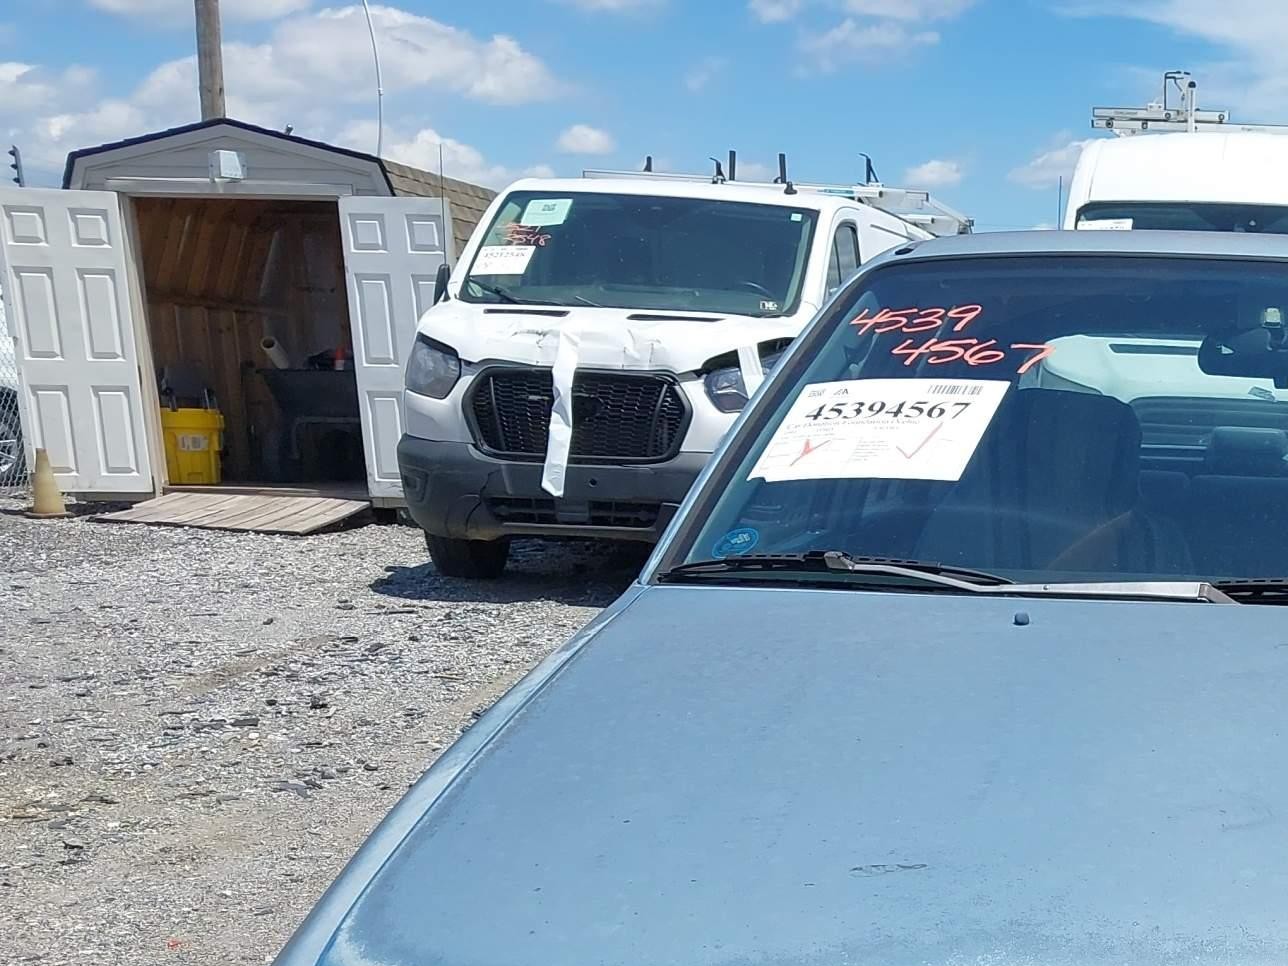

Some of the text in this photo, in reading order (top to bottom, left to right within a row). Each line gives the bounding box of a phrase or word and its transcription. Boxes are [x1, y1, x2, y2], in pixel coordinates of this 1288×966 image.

[849, 304, 983, 336] 4539
[890, 338, 1057, 374] 4567
[804, 400, 972, 421] 45394567
